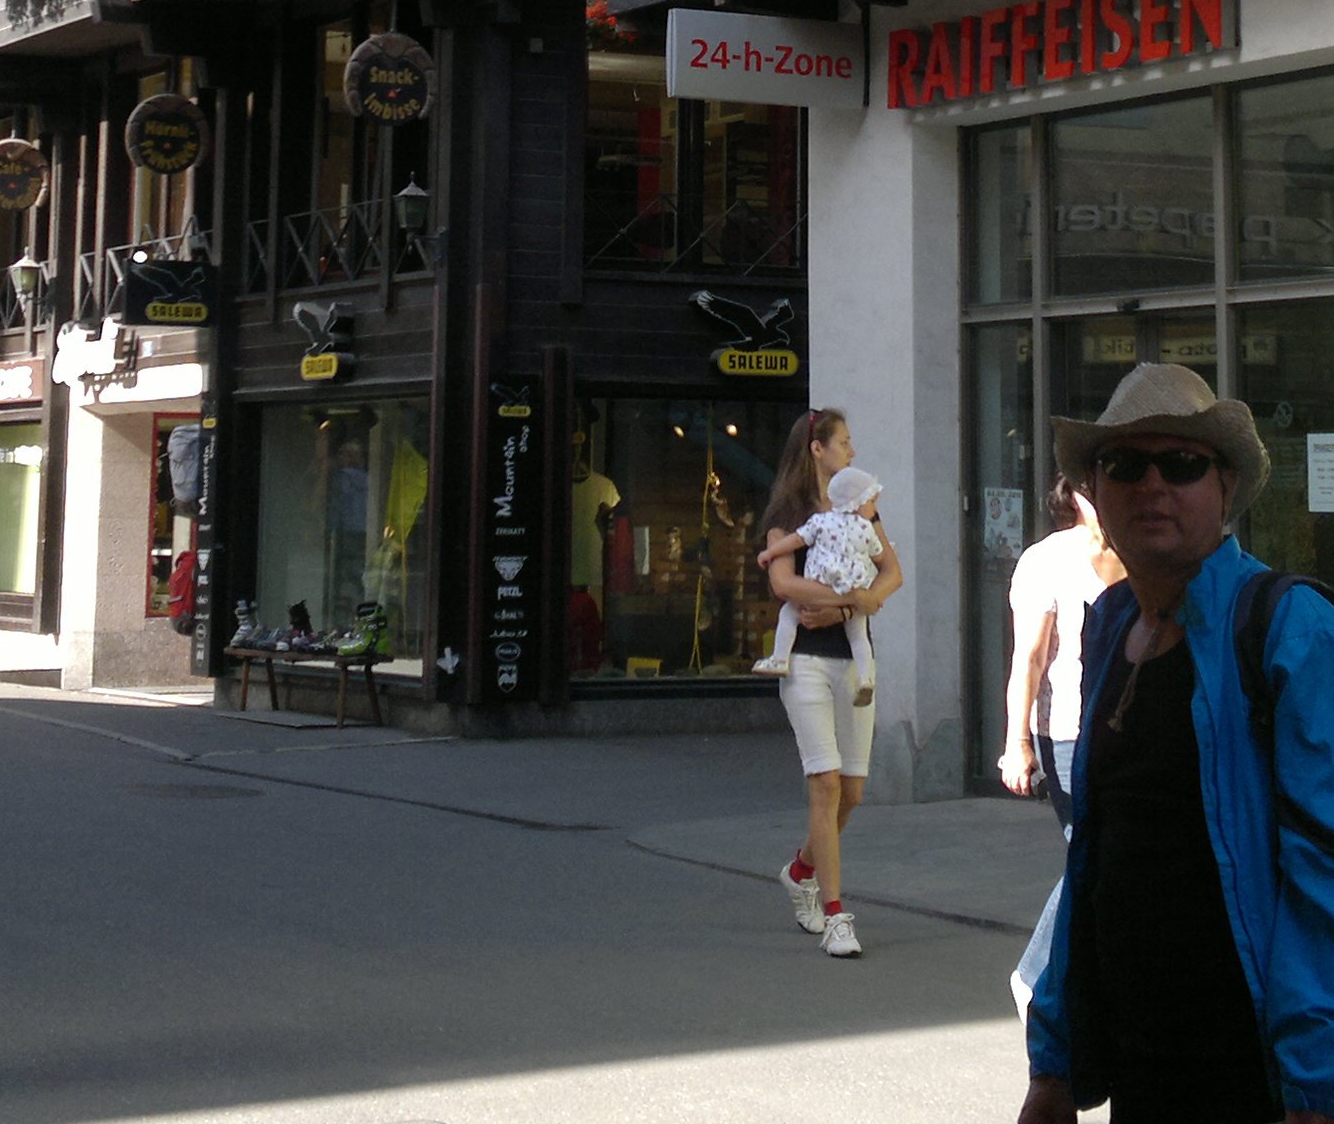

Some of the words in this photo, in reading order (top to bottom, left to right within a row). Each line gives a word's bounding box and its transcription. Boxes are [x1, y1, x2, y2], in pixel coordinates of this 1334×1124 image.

[690, 38, 853, 79] 24-h-Zone
[370, 66, 419, 84] Snack-
[152, 305, 203, 318] SALEWA
[728, 352, 789, 372] SALEWA
[493, 436, 516, 517] Mountain
